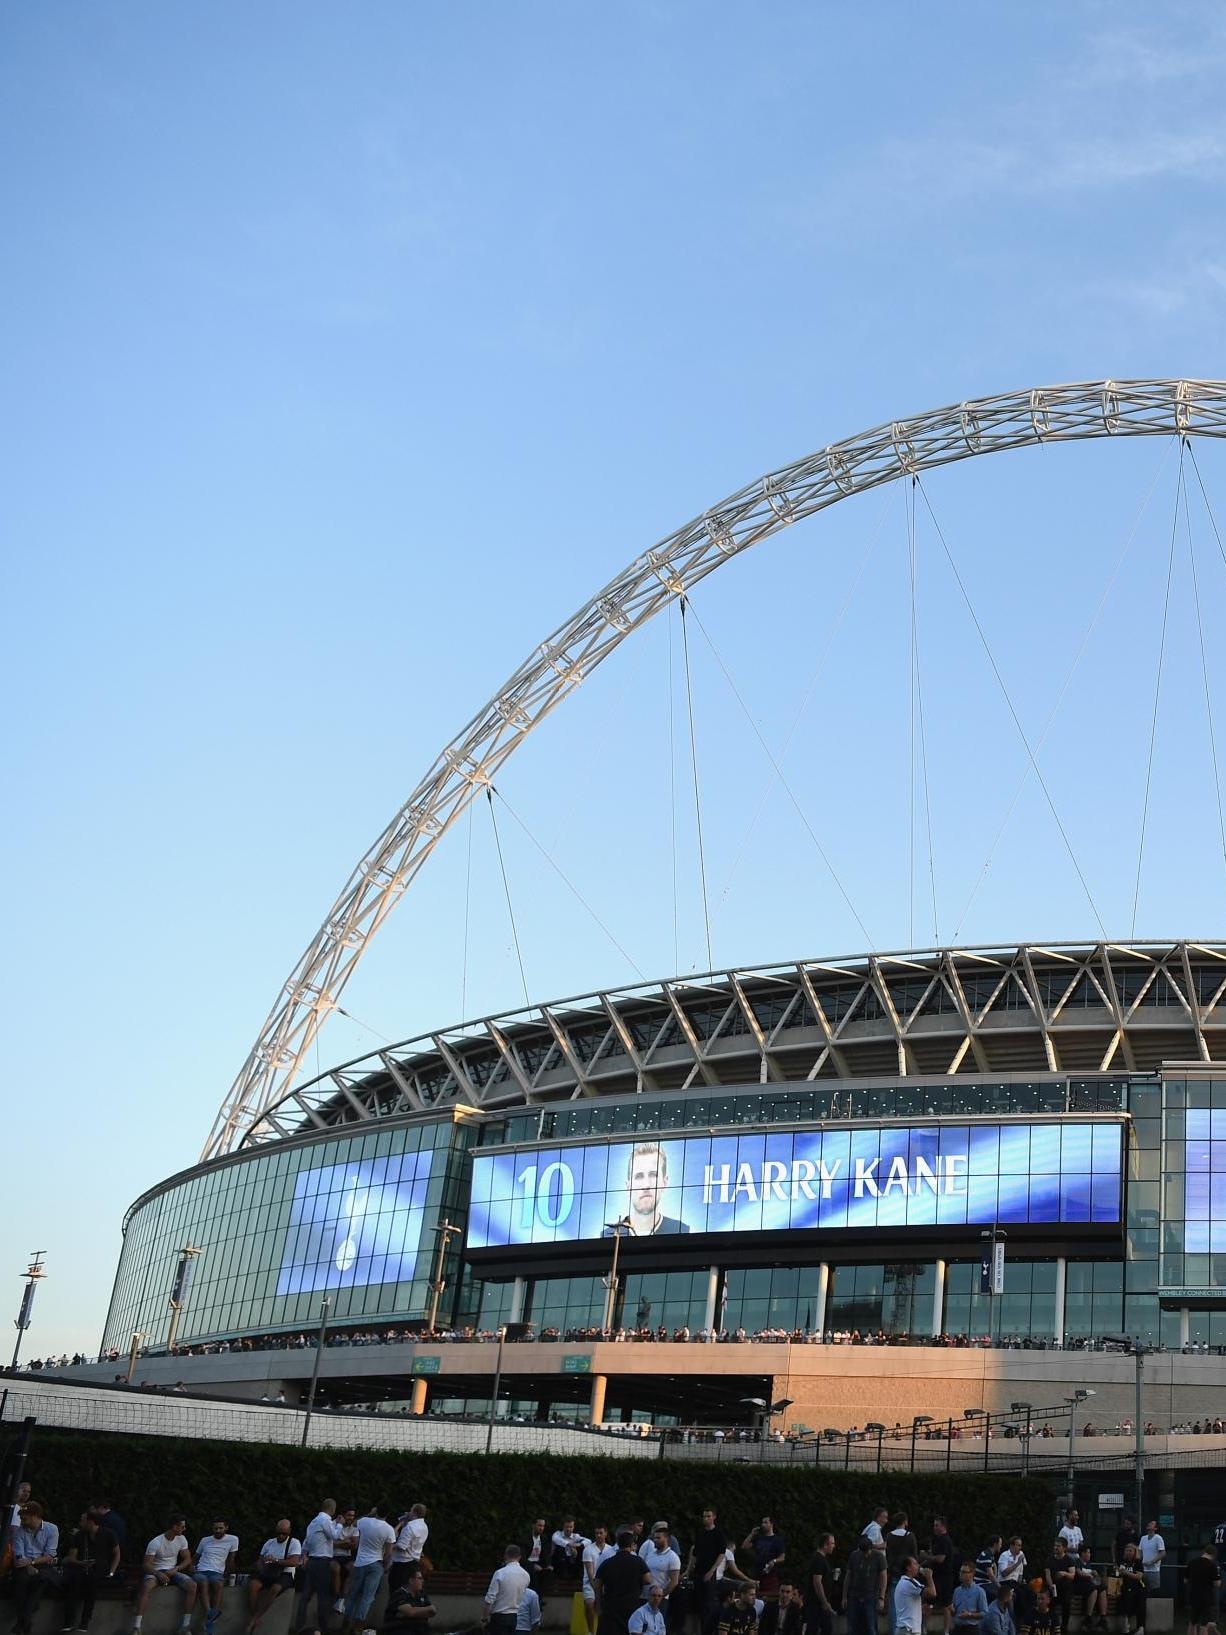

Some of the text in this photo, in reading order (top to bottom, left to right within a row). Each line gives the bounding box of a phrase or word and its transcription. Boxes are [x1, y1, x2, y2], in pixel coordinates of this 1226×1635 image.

[517, 1161, 575, 1228] 10
[703, 1155, 968, 1204] HARRY KANE
[1214, 1528, 1225, 1544] 22
